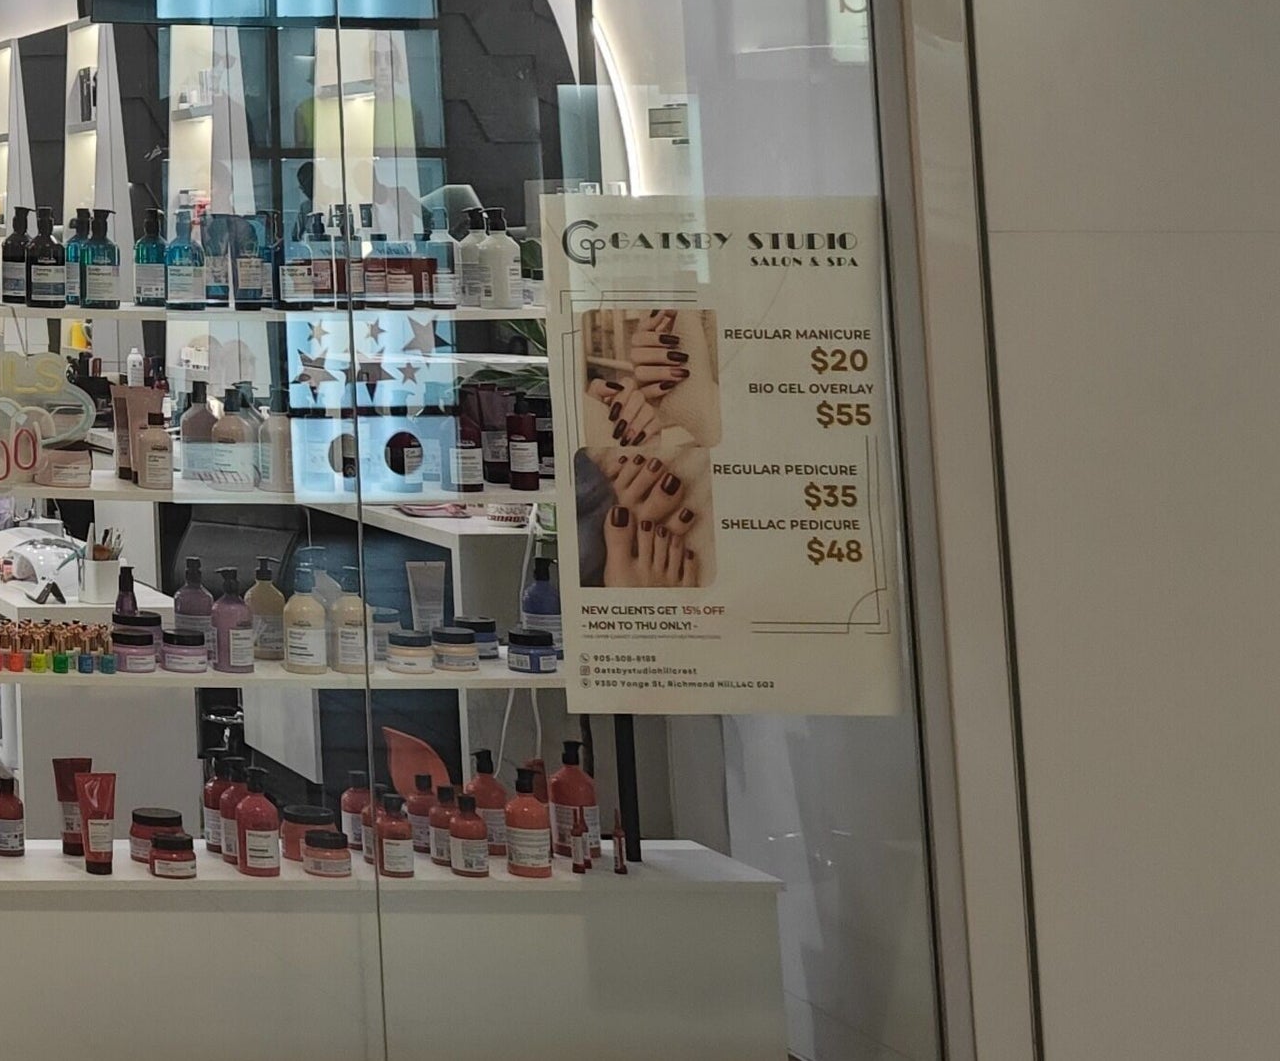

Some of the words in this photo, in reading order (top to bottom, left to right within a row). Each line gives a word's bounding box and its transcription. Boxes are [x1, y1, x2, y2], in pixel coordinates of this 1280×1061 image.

[609, 232, 732, 250] GATSBY
[748, 232, 858, 250] STUDIO
[750, 256, 802, 267] SALON
[827, 256, 859, 267] SPA
[724, 329, 791, 340] REGULAR
[796, 329, 871, 340] MANICURE
[811, 346, 868, 374] $20
[749, 383, 774, 394] BIO
[778, 383, 805, 394] GEL
[810, 383, 874, 394] OVERLAY
[816, 400, 872, 428] $55
[713, 464, 781, 475] REGULAR
[785, 464, 857, 476] PEDICURE
[805, 482, 857, 510] $35
[721, 519, 786, 530] SHELLAC
[791, 519, 860, 530] PEDICURE
[807, 537, 863, 565] $48
[581, 606, 608, 615] NEW
[611, 606, 655, 615] CLIENTS
[657, 606, 678, 615] GET
[682, 606, 700, 615] 15%
[703, 606, 725, 615] OFF
[588, 621, 615, 630] MON
[617, 621, 633, 630] TO
[634, 621, 657, 630] THU
[659, 621, 692, 630] ONLY!
[620, 680, 650, 689] Yonge
